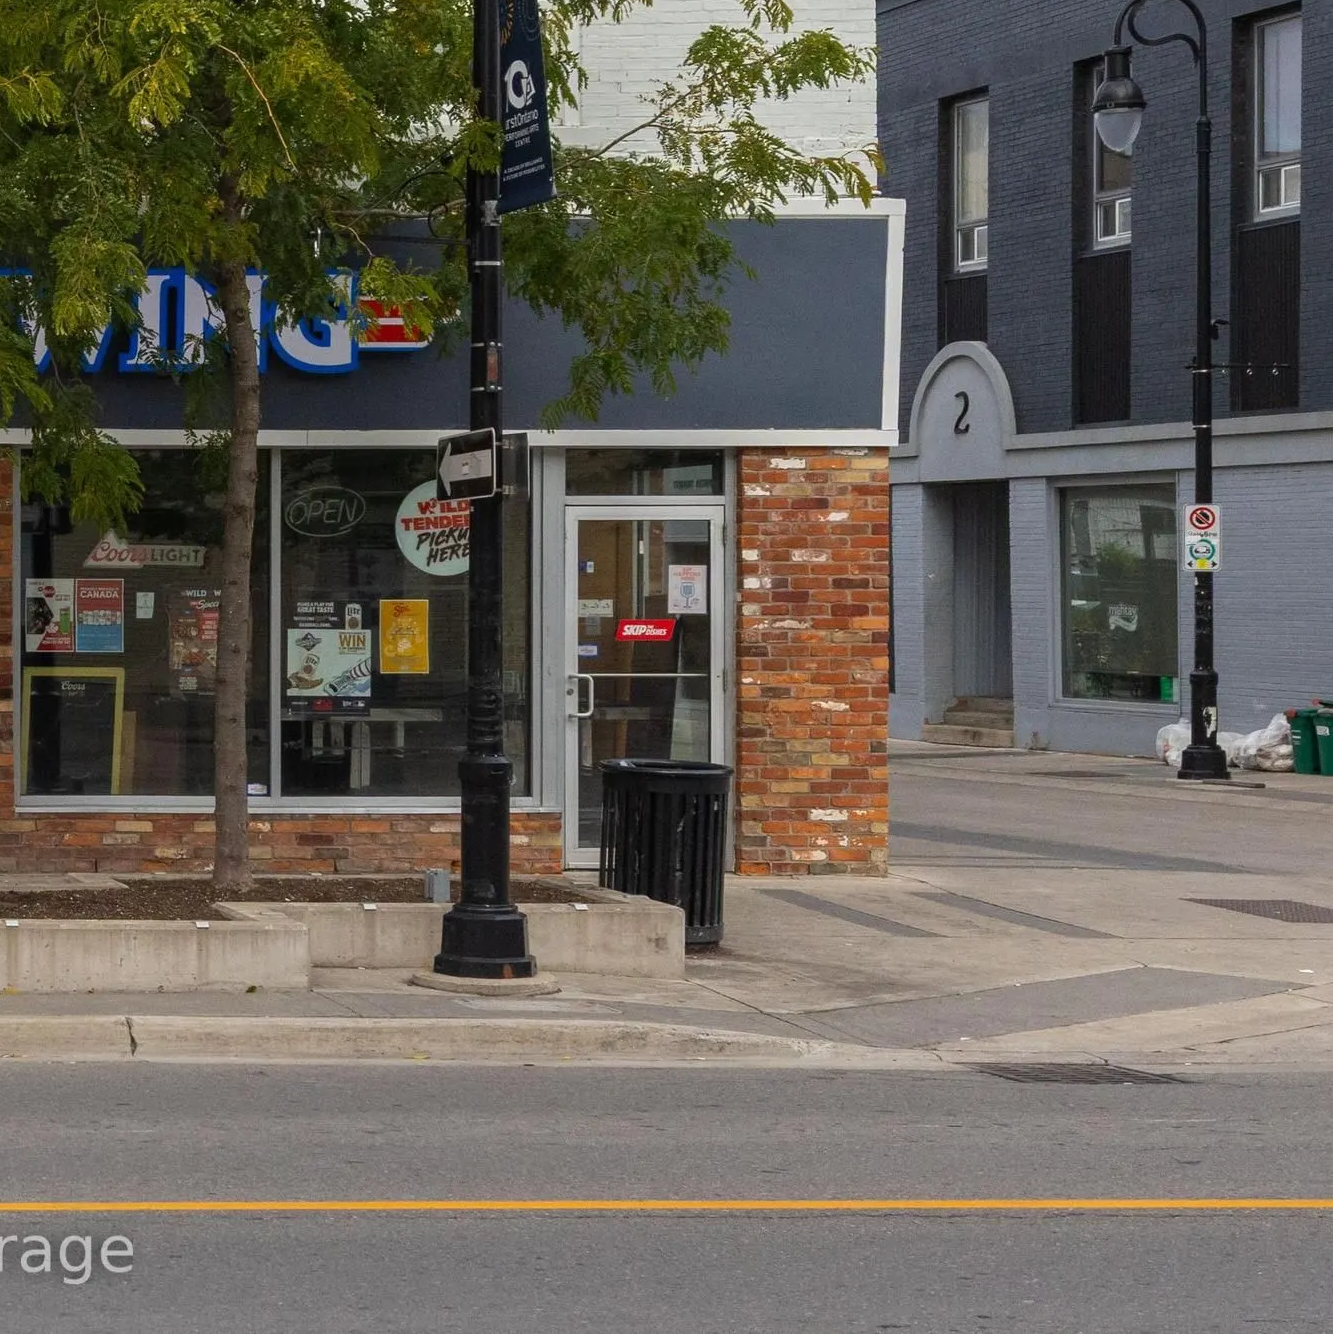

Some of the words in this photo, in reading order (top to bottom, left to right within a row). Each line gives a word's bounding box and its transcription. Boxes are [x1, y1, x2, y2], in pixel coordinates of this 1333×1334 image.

[954, 391, 970, 434] 2
[289, 499, 358, 525] OPEN
[417, 498, 470, 515] WILD
[416, 527, 470, 551] PICKU
[92, 541, 147, 564] Coors
[150, 548, 200, 562] LIGHT
[427, 543, 470, 567] HERE
[80, 590, 119, 599] CANADA
[185, 589, 207, 597] WILD
[623, 625, 646, 636] SKIP
[338, 634, 366, 646] WIN
[61, 681, 86, 691] Coors
